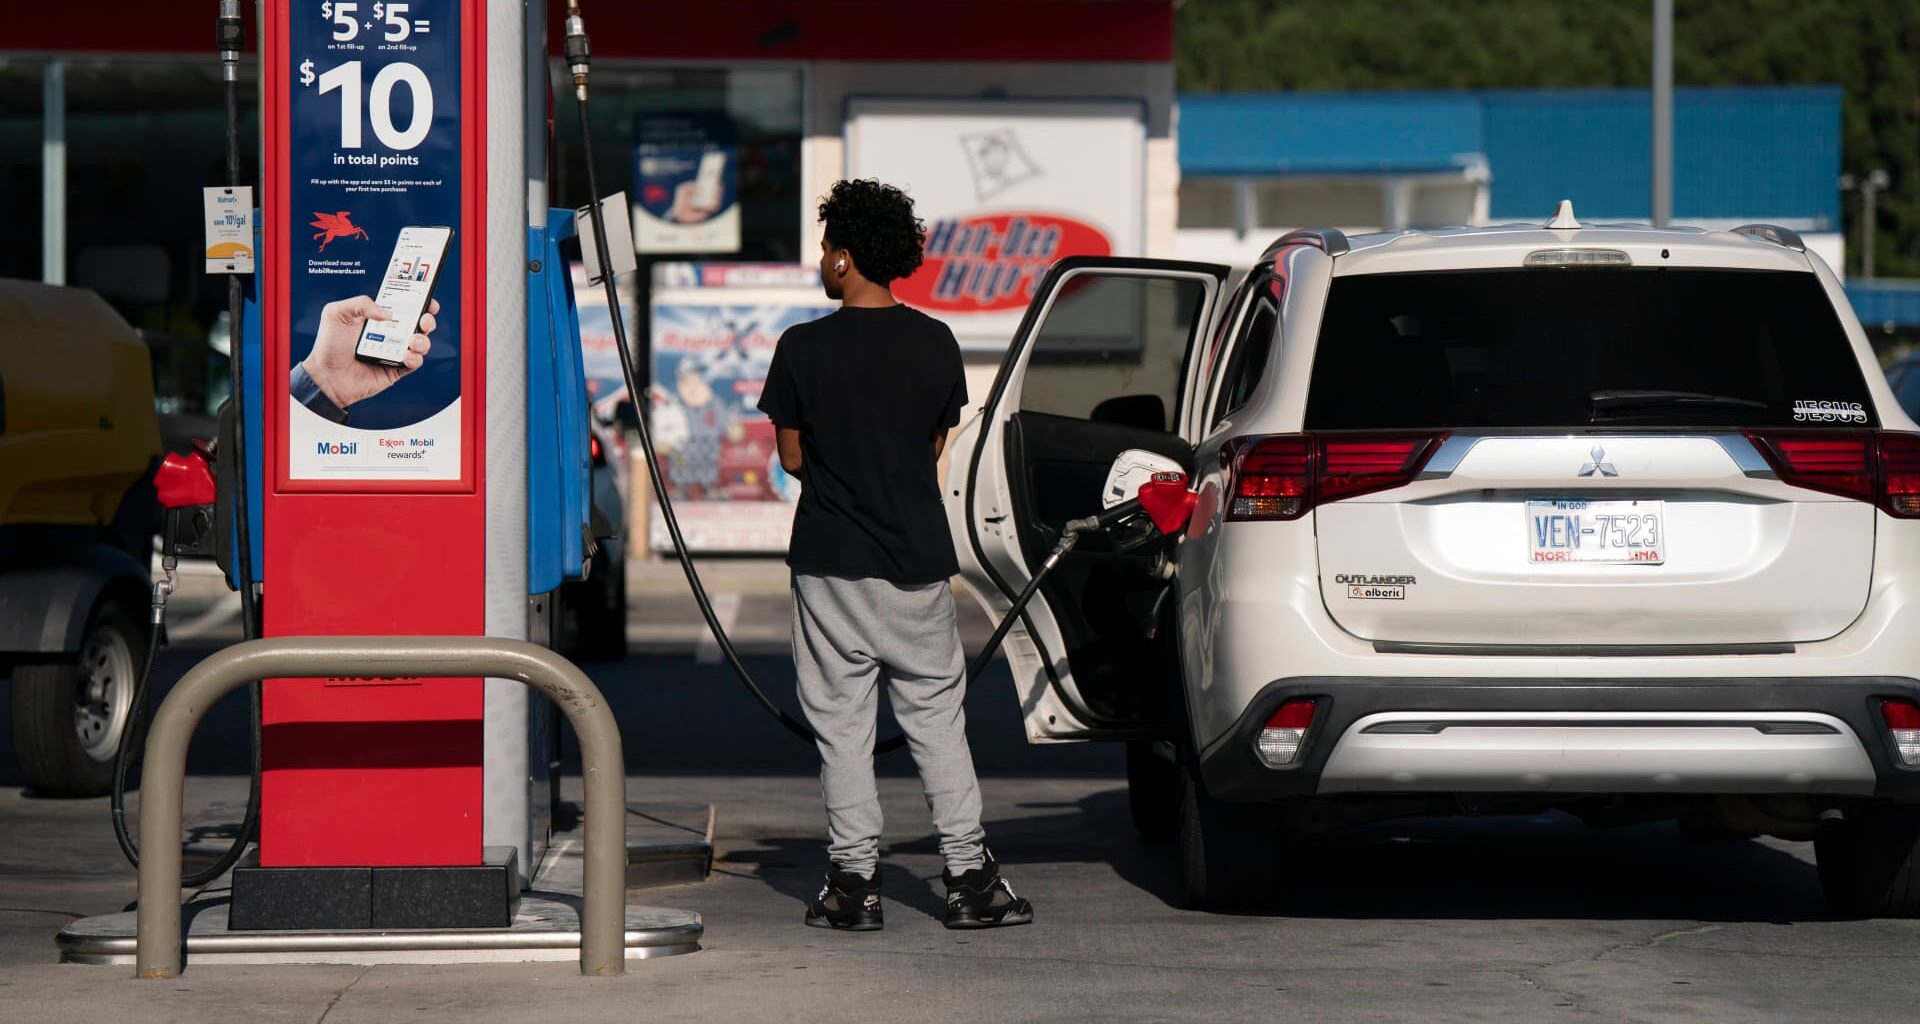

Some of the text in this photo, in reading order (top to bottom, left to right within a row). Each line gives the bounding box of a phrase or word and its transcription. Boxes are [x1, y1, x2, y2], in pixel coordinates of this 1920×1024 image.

[321, 0, 359, 41] $5
[373, 1, 411, 42] $5
[347, 43, 365, 51] fill-up
[399, 44, 417, 52] fill-up
[299, 58, 434, 151] $10
[333, 153, 419, 168] in total points
[350, 179, 360, 187] app
[397, 179, 414, 187] points
[308, 267, 366, 275] MobilRewards.com
[1792, 400, 1868, 423] JESUS
[378, 438, 434, 448] Exxon Mobil
[317, 442, 357, 455] Mobil
[1557, 501, 1588, 510] IN GOD
[1535, 514, 1659, 549] VEN-7523
[1335, 574, 1416, 585] OUTLANDER
[1365, 587, 1400, 597] alberic
